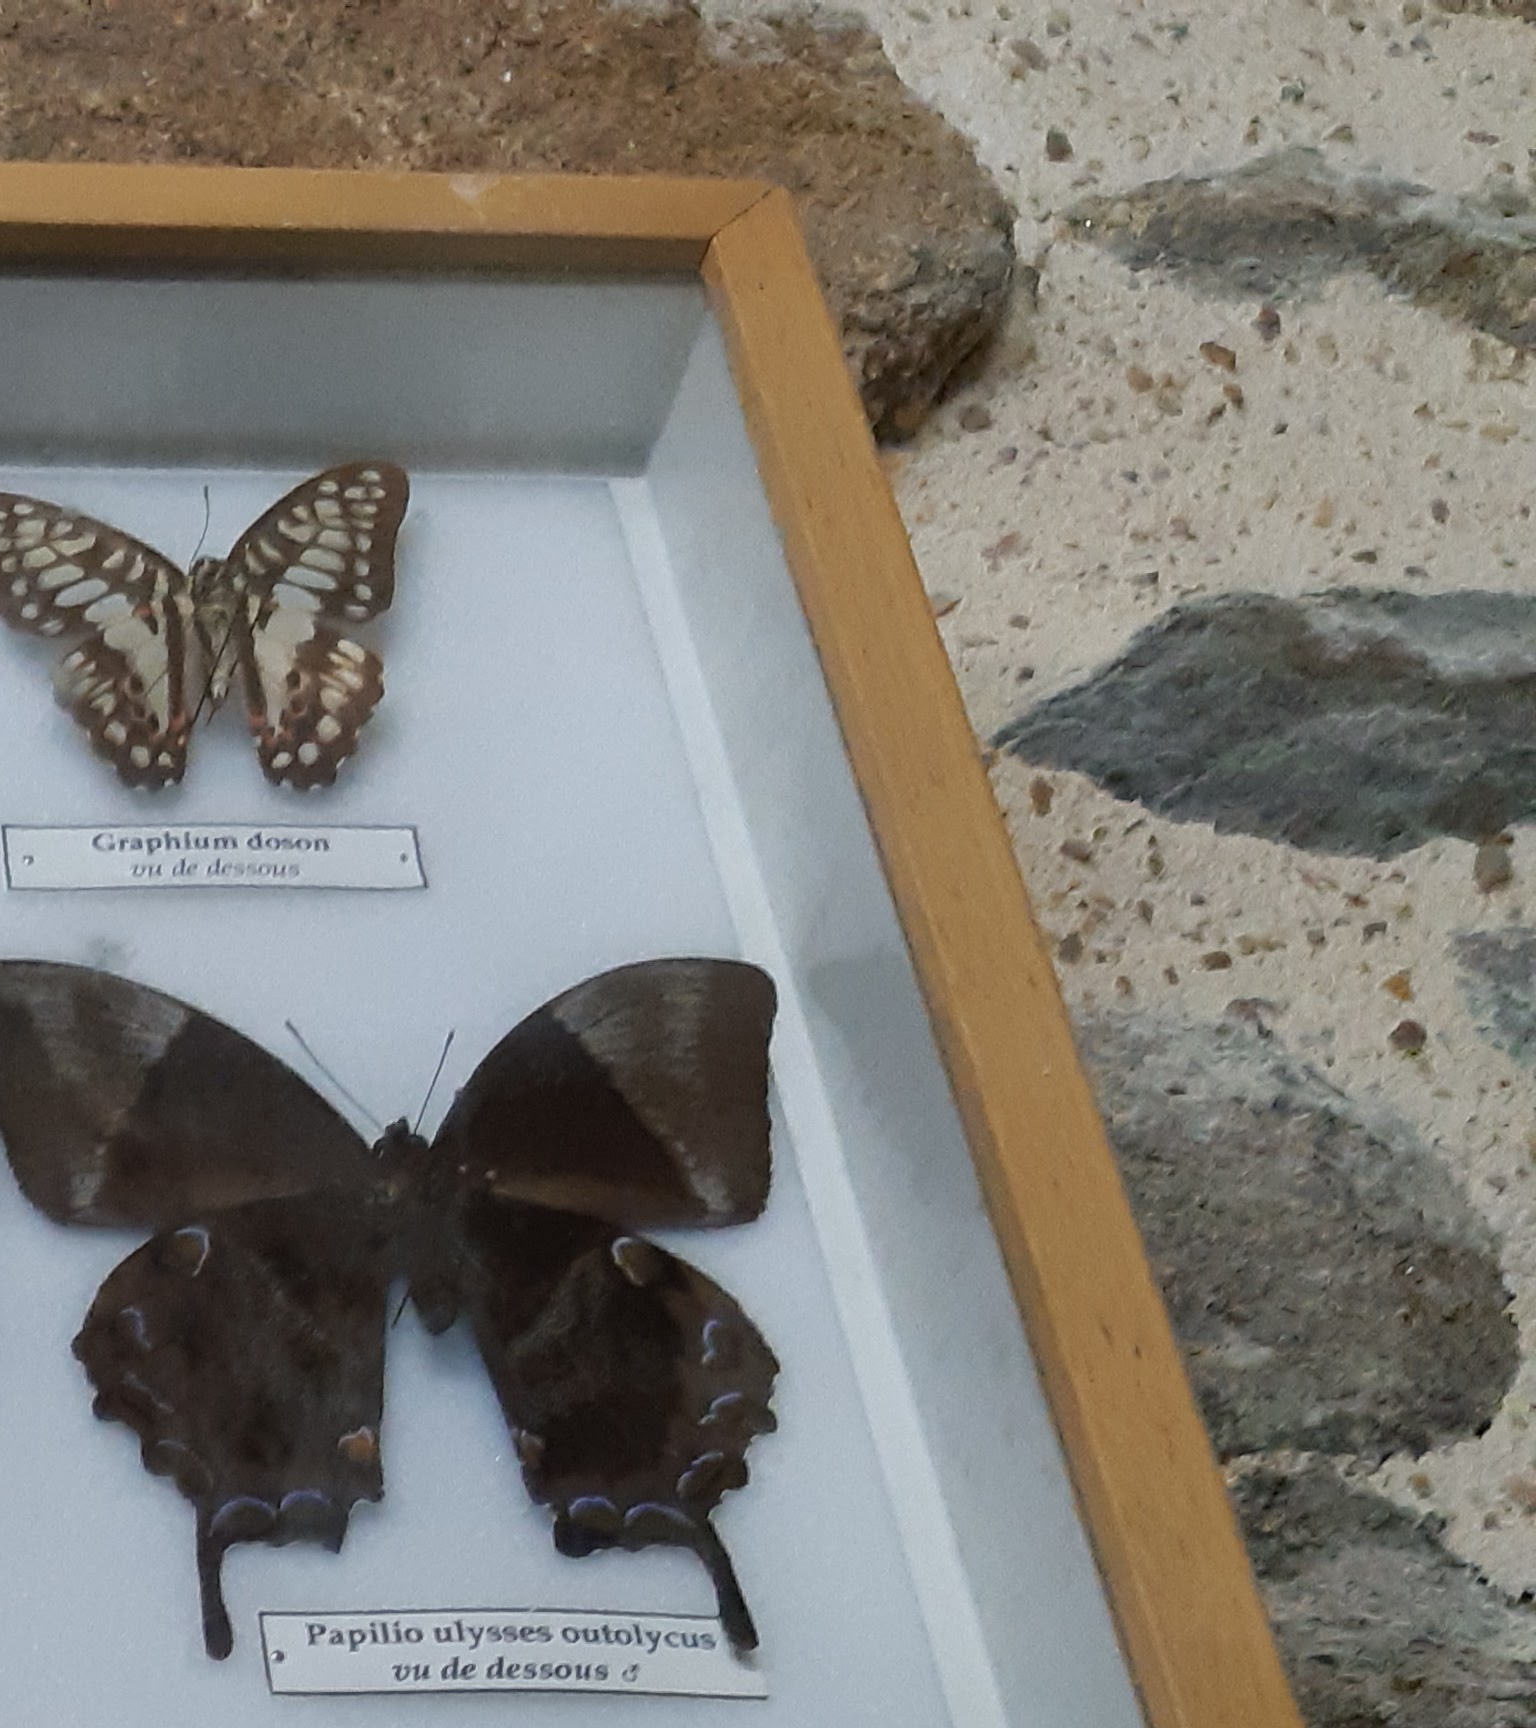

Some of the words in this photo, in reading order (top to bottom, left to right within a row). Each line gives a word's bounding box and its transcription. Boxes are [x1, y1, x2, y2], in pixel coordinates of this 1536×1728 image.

[92, 831, 237, 855] Graphium
[246, 832, 330, 852] doson
[130, 863, 163, 879] vu
[171, 859, 198, 878] de
[206, 860, 300, 879] dessous
[305, 1622, 424, 1652] Papilio
[434, 1620, 553, 1650] ulysses
[561, 1623, 717, 1654] outolycus
[391, 1663, 431, 1681] vu
[440, 1658, 477, 1680] de
[486, 1658, 609, 1682] dessous
